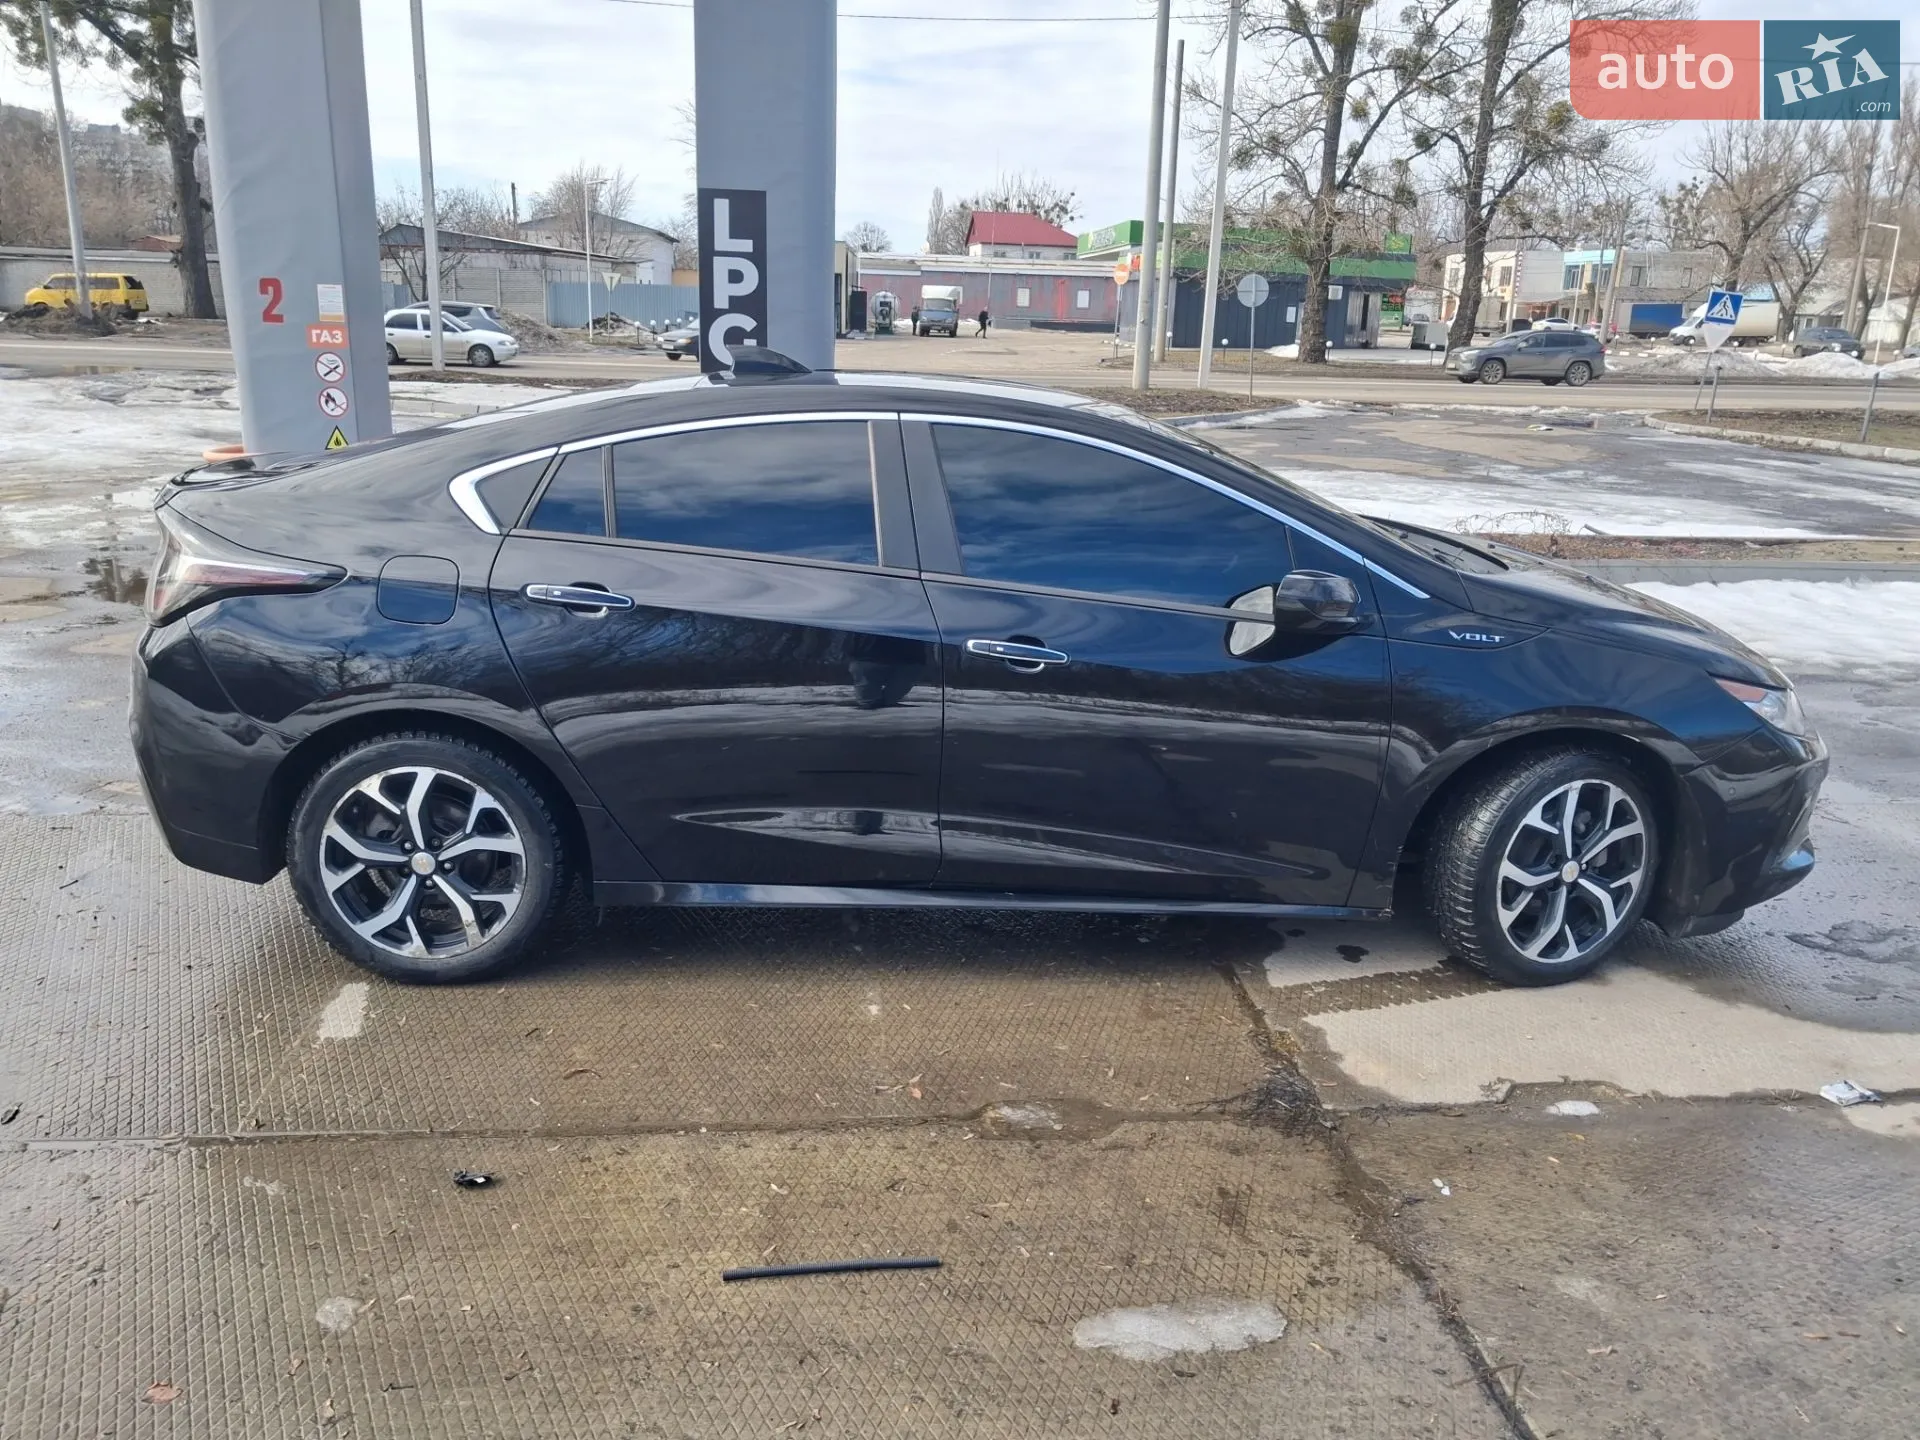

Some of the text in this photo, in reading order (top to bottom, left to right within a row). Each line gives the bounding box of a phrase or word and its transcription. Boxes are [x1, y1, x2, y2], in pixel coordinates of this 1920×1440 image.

[259, 277, 284, 323] 2
[311, 329, 343, 344] ГАЗ
[1448, 629, 1505, 643] VOLT
